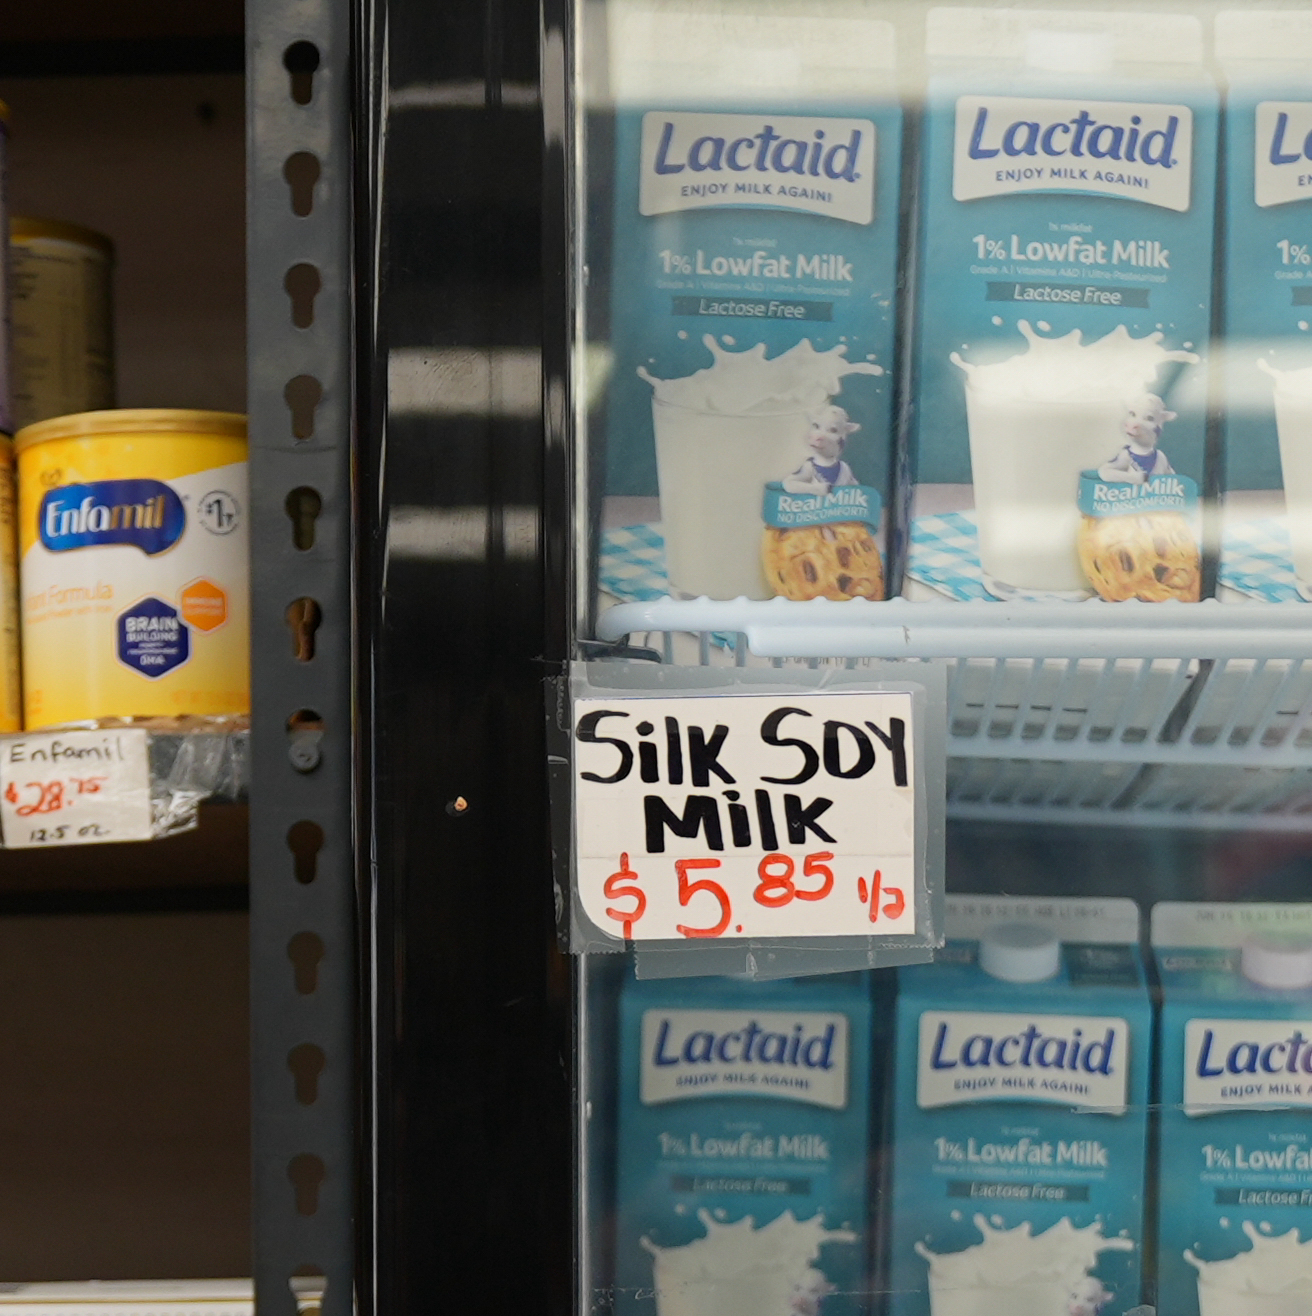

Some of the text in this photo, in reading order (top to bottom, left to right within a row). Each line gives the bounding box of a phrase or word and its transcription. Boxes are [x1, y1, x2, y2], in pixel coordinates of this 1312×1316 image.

[654, 122, 861, 183] Lactaid
[968, 106, 1178, 169] Lactaid
[681, 182, 832, 203] ENJOY MILK AGAIN!
[658, 250, 854, 282] 1% Lowfat Milk
[973, 234, 1171, 268] 1% Lowfat Milk
[1276, 239, 1311, 265] 1%
[699, 300, 804, 319] Lactose Free
[1014, 284, 1122, 305] Lactose Free
[777, 487, 869, 513] Real Milk
[46, 502, 164, 537] Enfamil
[11, 742, 125, 764] Enfamil
[760, 707, 908, 787] SOY
[603, 852, 647, 939] $
[675, 851, 835, 938] 5.85
[653, 1017, 835, 1070] Lactaid
[930, 1021, 1114, 1076] Lactaid
